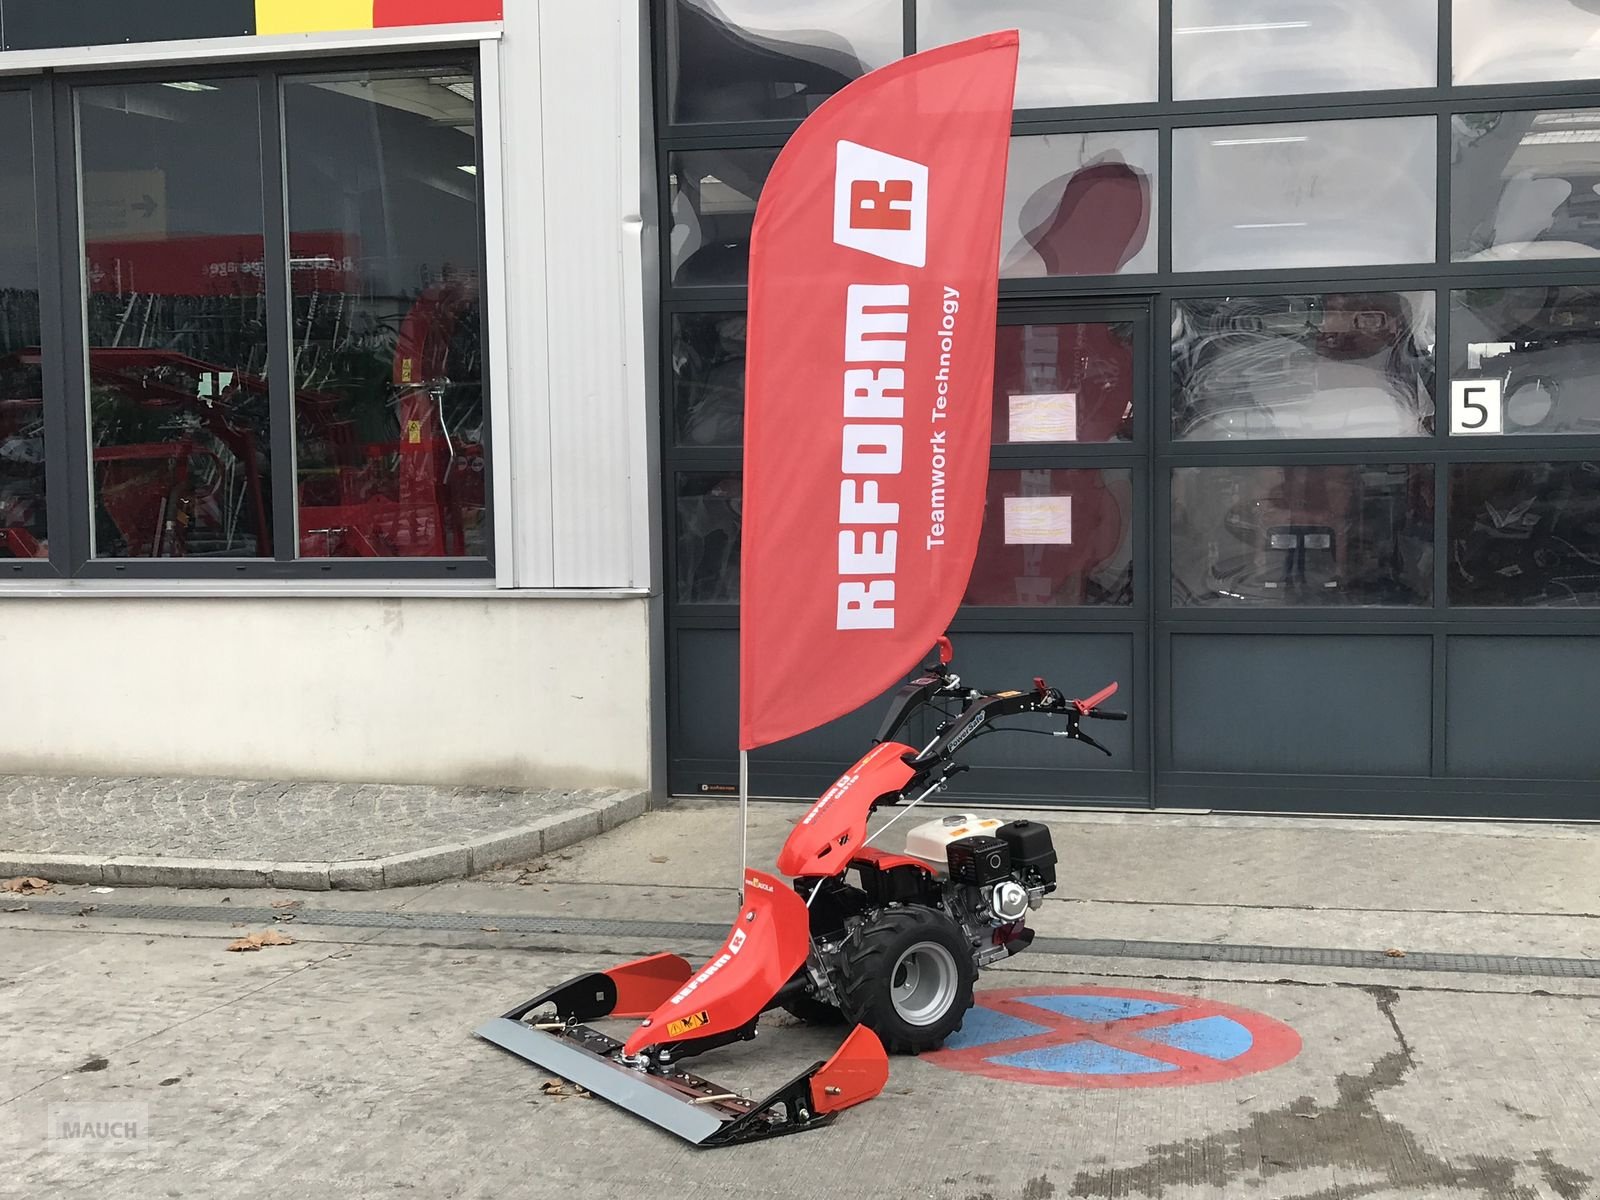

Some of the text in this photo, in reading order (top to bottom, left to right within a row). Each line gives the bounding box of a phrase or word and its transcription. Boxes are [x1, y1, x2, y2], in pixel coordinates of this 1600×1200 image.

[836, 179, 913, 631] REFORM R
[926, 285, 961, 550] Teamwork Technology
[1461, 387, 1489, 429] 5
[670, 953, 731, 1005] REFORM
